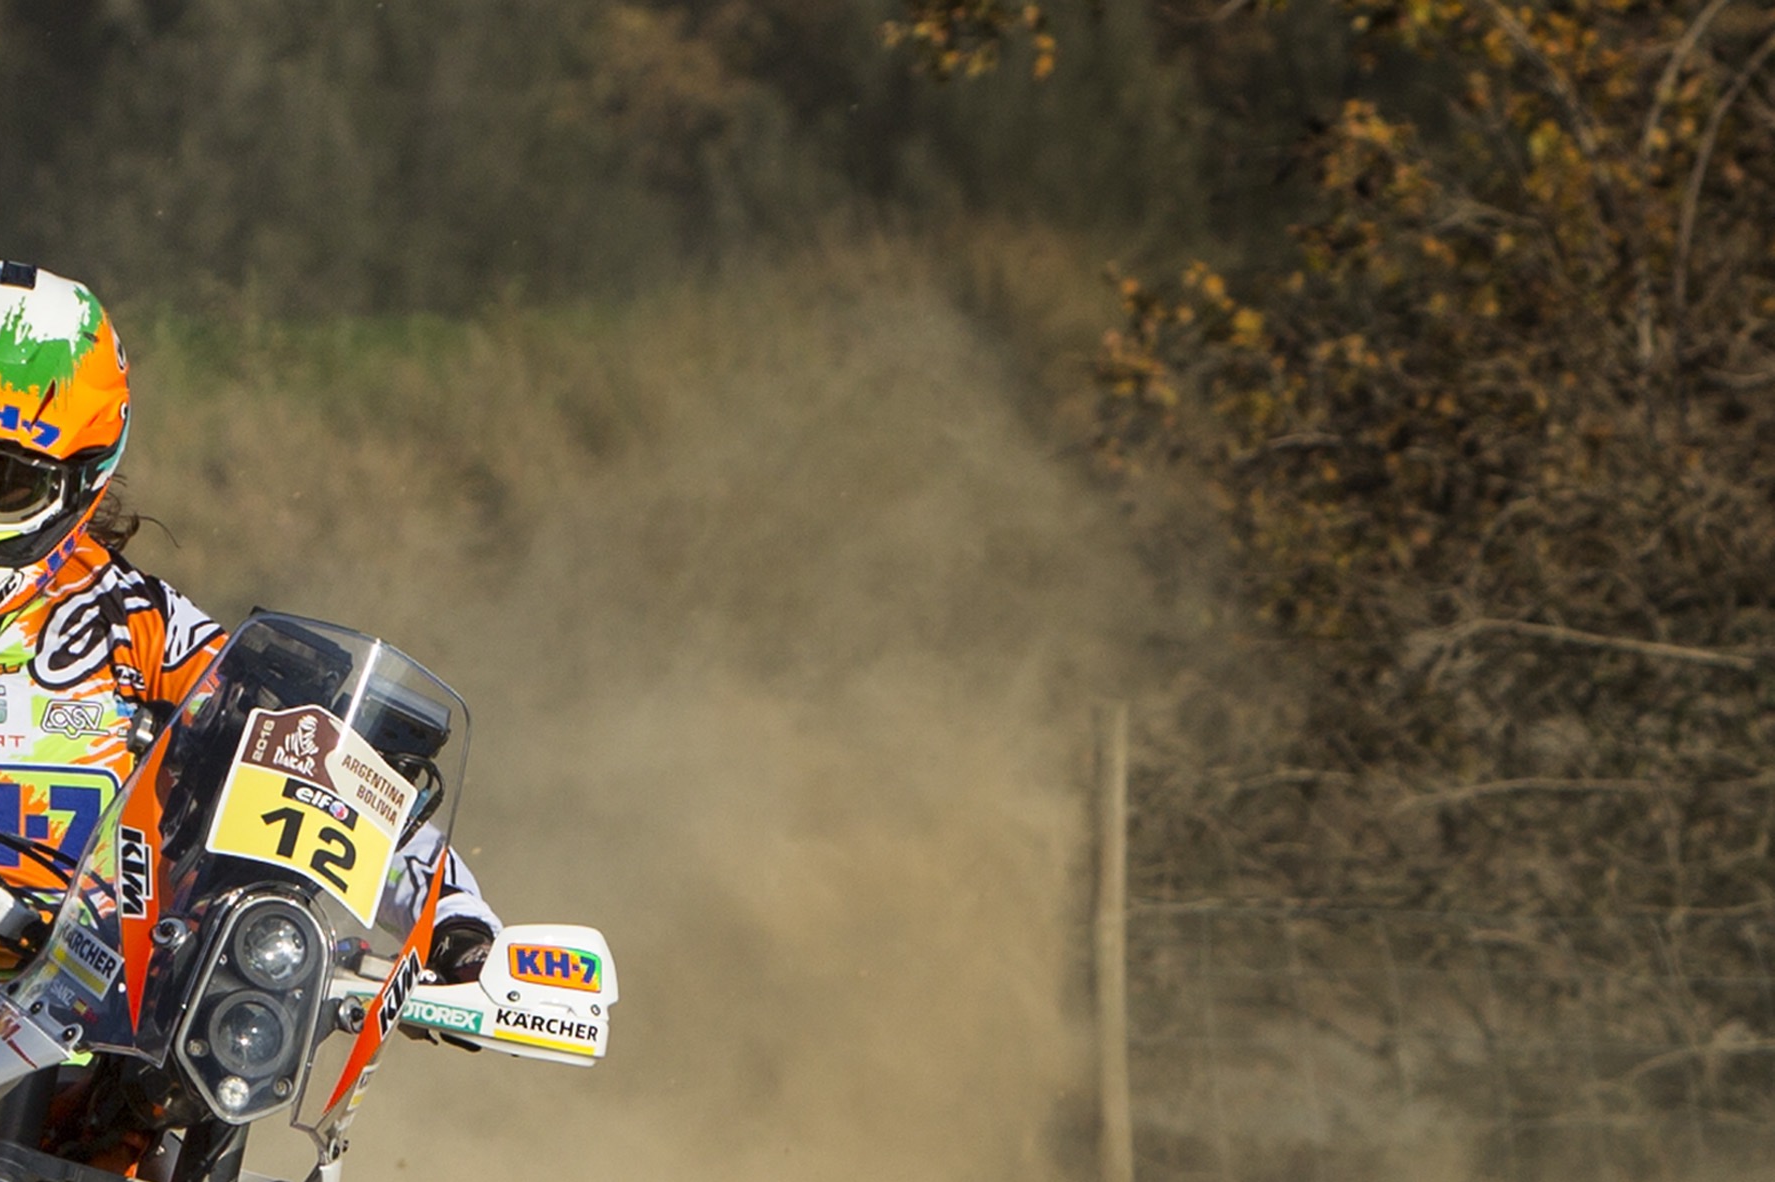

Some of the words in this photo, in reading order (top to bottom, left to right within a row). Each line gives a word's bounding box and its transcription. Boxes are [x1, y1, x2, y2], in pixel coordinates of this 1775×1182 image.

[295, 787, 334, 811] elf
[341, 754, 406, 809] ARGENTINA
[356, 785, 400, 826] BOLIVIA
[260, 807, 357, 894] 12
[120, 825, 152, 917] KTM
[516, 949, 596, 984] KH-7
[402, 1000, 476, 1029] OTOREX
[496, 1008, 599, 1042] KÄRCHER
